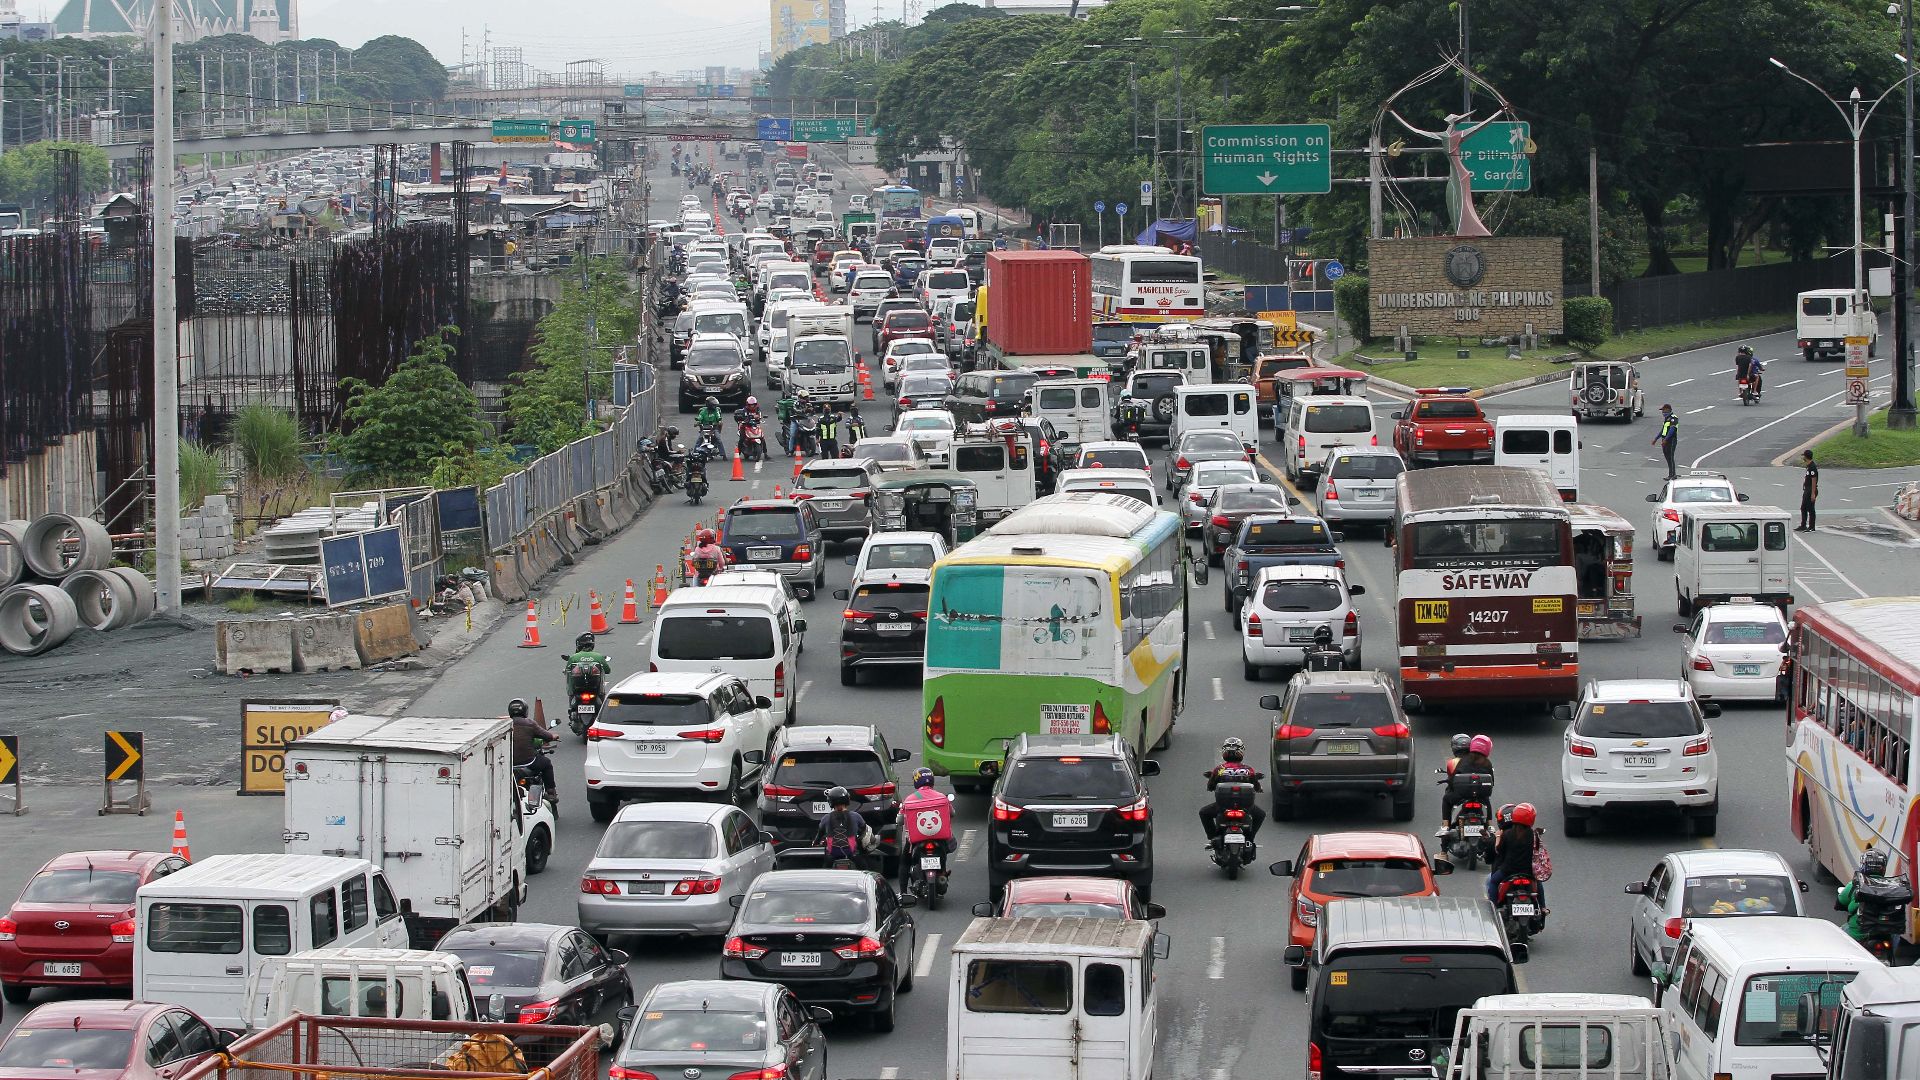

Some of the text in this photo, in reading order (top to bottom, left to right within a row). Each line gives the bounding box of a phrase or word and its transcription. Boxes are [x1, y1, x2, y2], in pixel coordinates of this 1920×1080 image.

[1208, 135, 1324, 147] Commission on
[1213, 150, 1320, 165] Human Rights
[1478, 149, 1526, 161] Diliman
[1484, 170, 1524, 180] Garcia
[1137, 286, 1174, 294] MAGICLINE
[1469, 293, 1487, 307] NG
[1491, 291, 1554, 307] PILIPINAS
[1454, 308, 1480, 321] 1908
[1442, 572, 1533, 591] SAFEWAY
[1416, 602, 1448, 620] TXM 408
[1468, 610, 1509, 623] 14207
[1053, 816, 1087, 825] NDT 6285
[782, 953, 820, 964] NAP 3280
[62, 965, 81, 974] 6853
